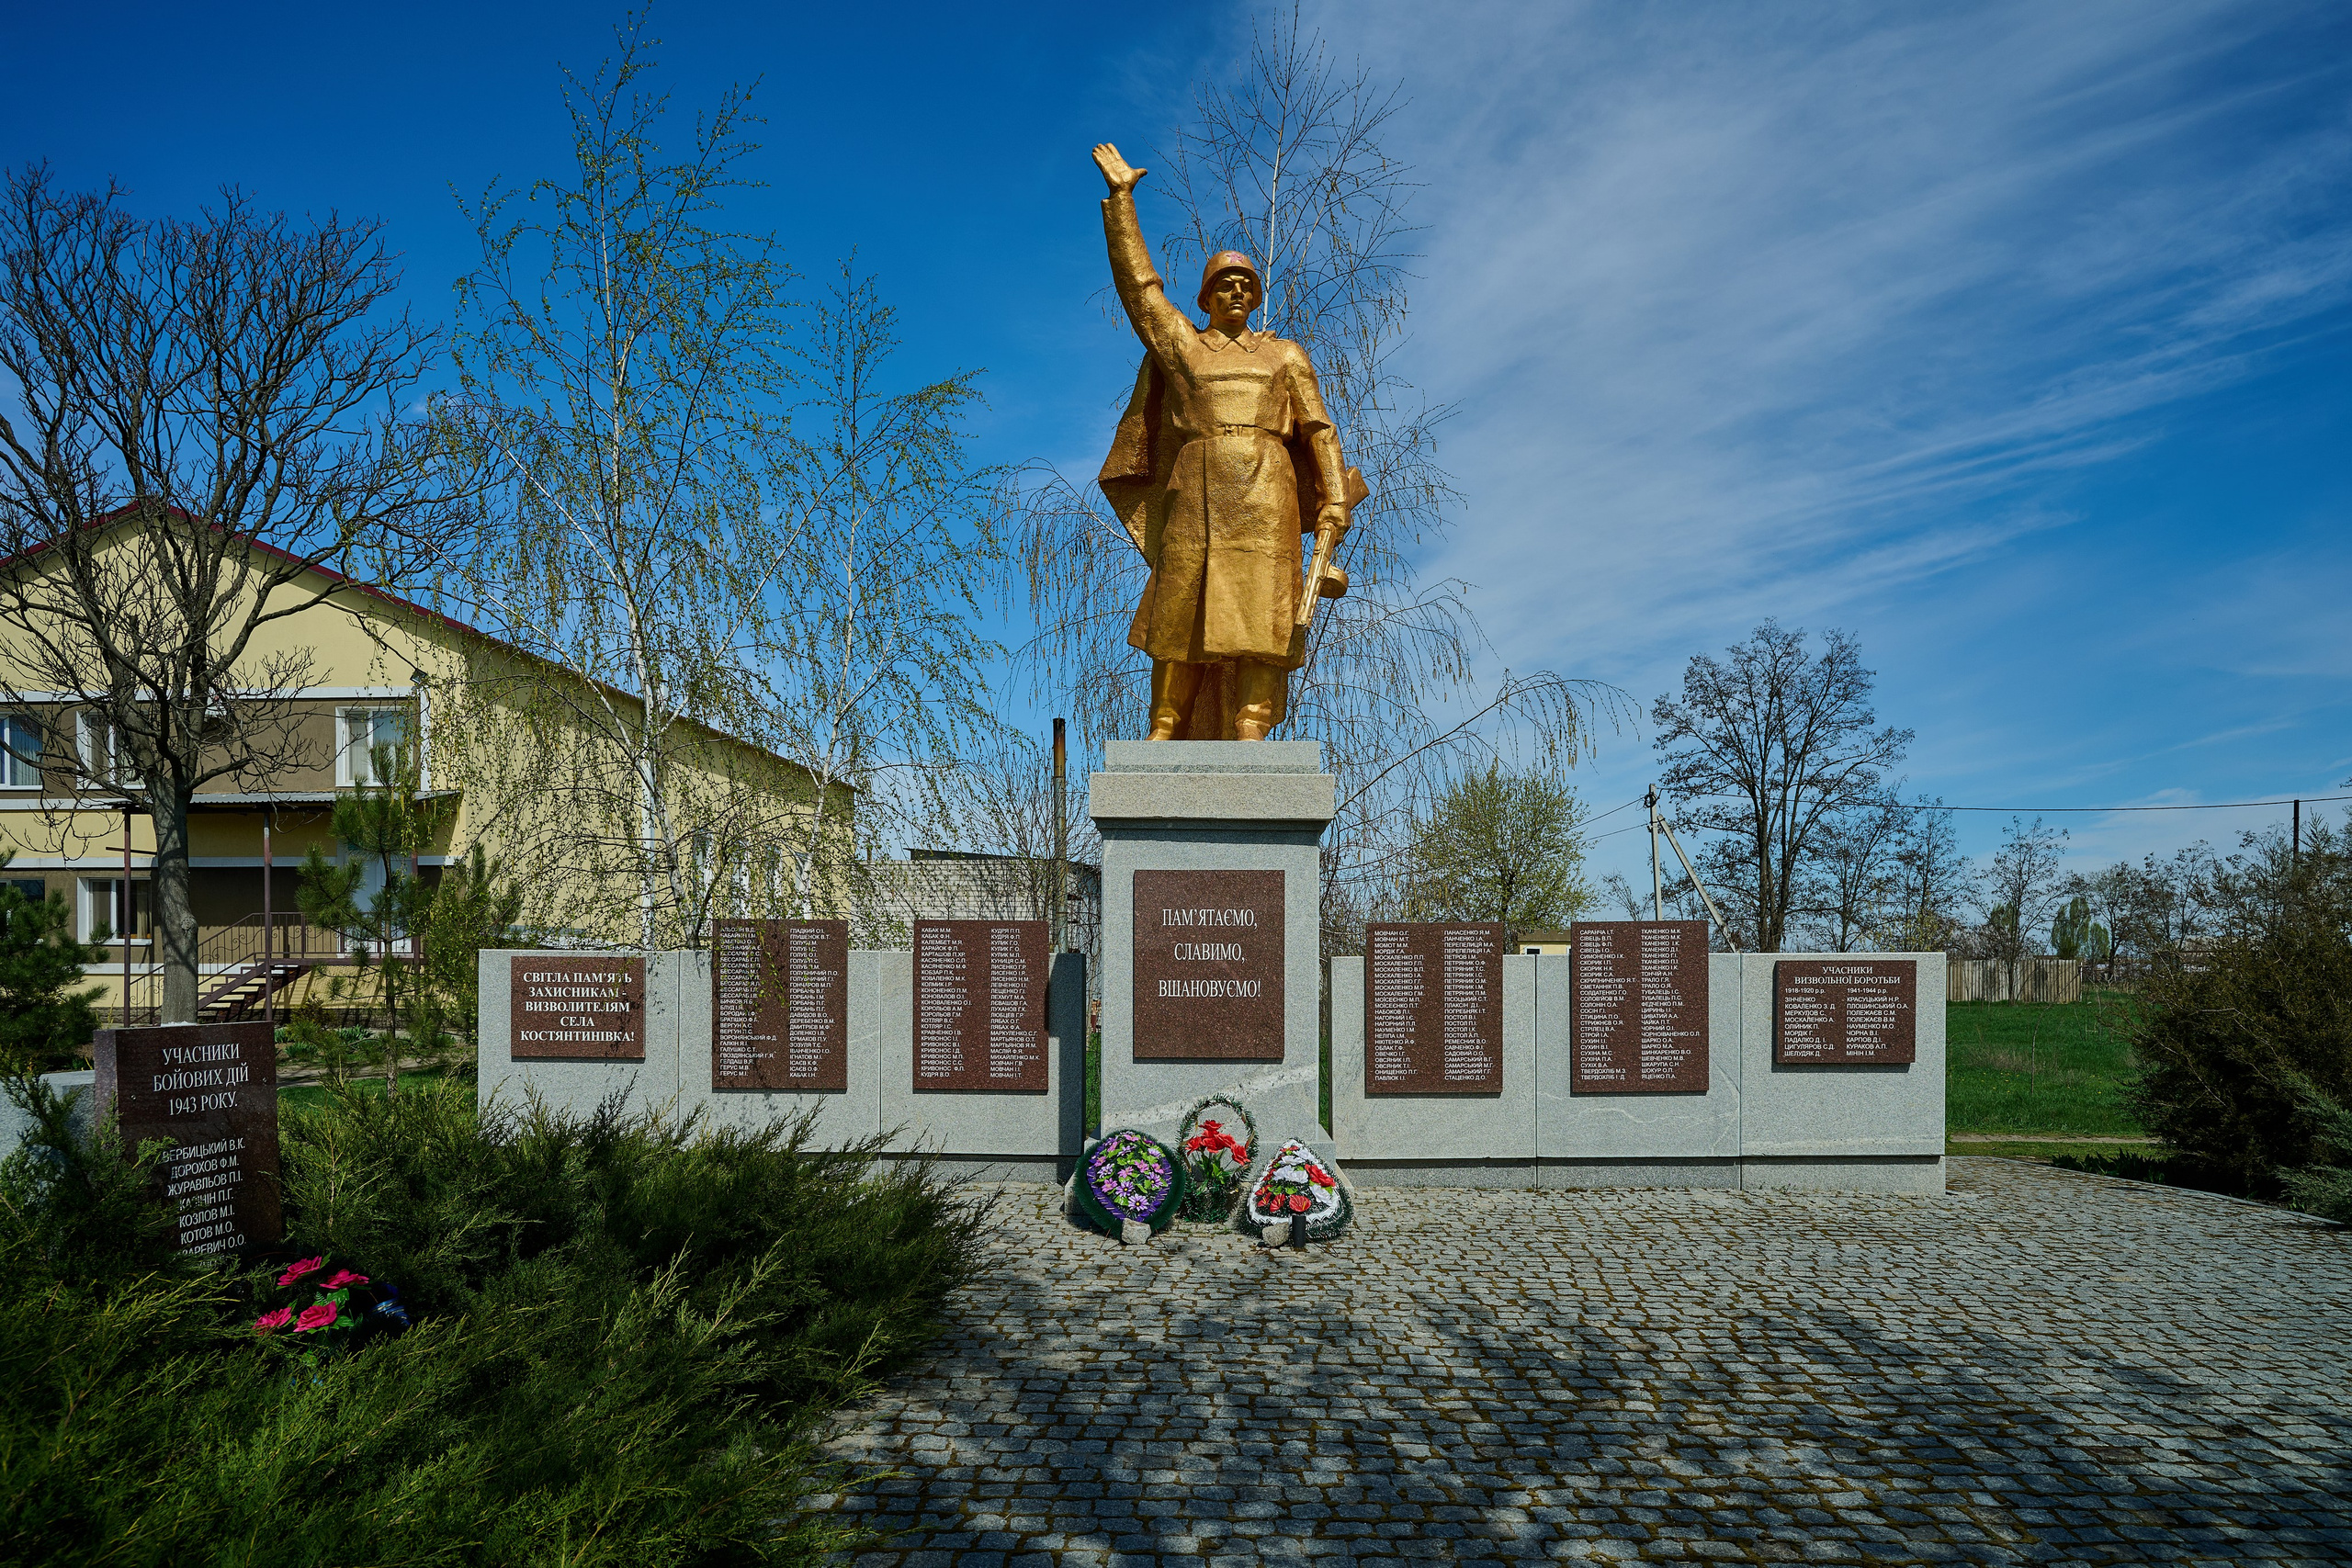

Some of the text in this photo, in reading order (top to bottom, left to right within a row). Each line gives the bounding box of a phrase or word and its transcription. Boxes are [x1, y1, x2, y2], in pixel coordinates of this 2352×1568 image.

[1163, 909, 1257, 929] ПАМ’ЯТАЄМО,
[1175, 943, 1245, 963] СЛАВИМО,
[523, 972, 570, 982] СВІТЛА
[1795, 976, 1852, 984] ВИЗВОЛЬНОЇ
[529, 987, 619, 997] ЗАХИСНИКАМ
[1158, 980, 1261, 997] ВШАНОВУЄМО!
[526, 1002, 630, 1012] ВИЗВОЛИТЕЛЯМ
[560, 1017, 595, 1027] СЕЛА
[521, 1031, 634, 1041] КОСТЯНТИНІВКА!
[162, 1043, 240, 1065] УЧАСНИКИ
[153, 1062, 249, 1092] БОЙОВИХ ДІЙ
[169, 1091, 238, 1116] 1943 РОКУ.
[162, 1137, 245, 1163] ВЕРБИЦЬКИЙ В.К.
[171, 1155, 239, 1180] ДОРОХОВ Ф.М.
[167, 1170, 243, 1197] ЖУРАВЛЬОВ П.І.
[218, 1188, 234, 1202] П.Г.
[179, 1204, 235, 1228] КОЗЛОВ М.І.
[180, 1221, 235, 1245] КОТОВ М.О.
[228, 1234, 247, 1248] О.О.
